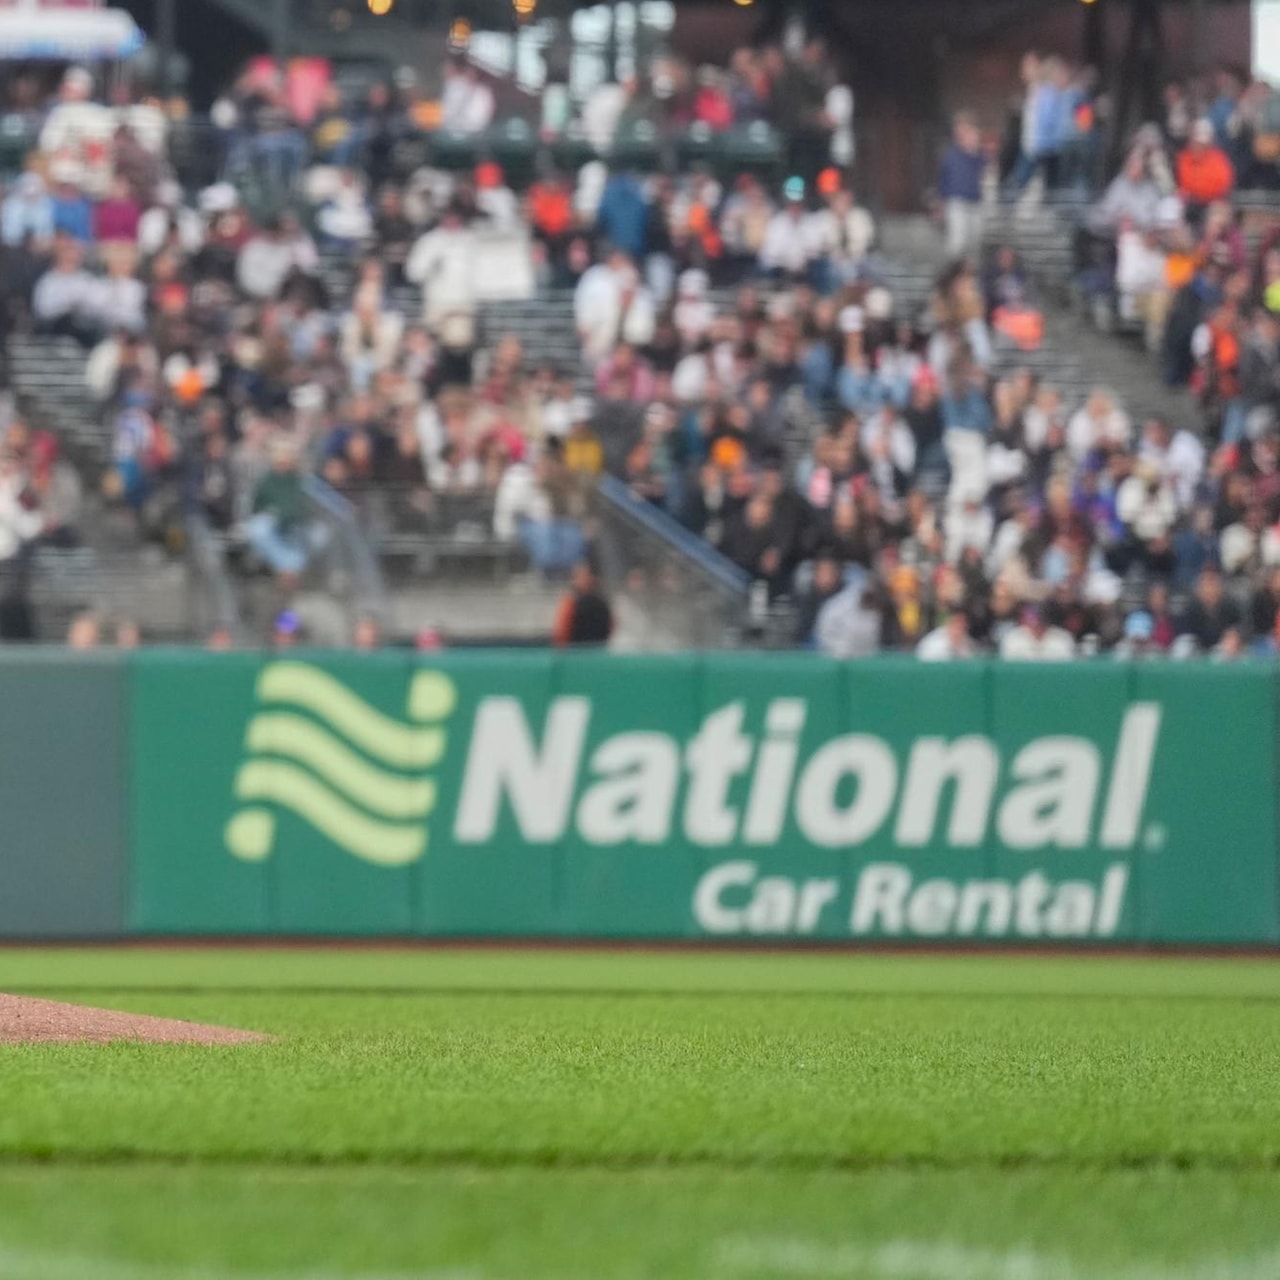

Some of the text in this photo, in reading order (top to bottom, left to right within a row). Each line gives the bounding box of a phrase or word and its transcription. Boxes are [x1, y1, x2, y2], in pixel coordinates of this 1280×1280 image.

[453, 694, 1162, 850] National
[690, 860, 1128, 939] Car Rental
